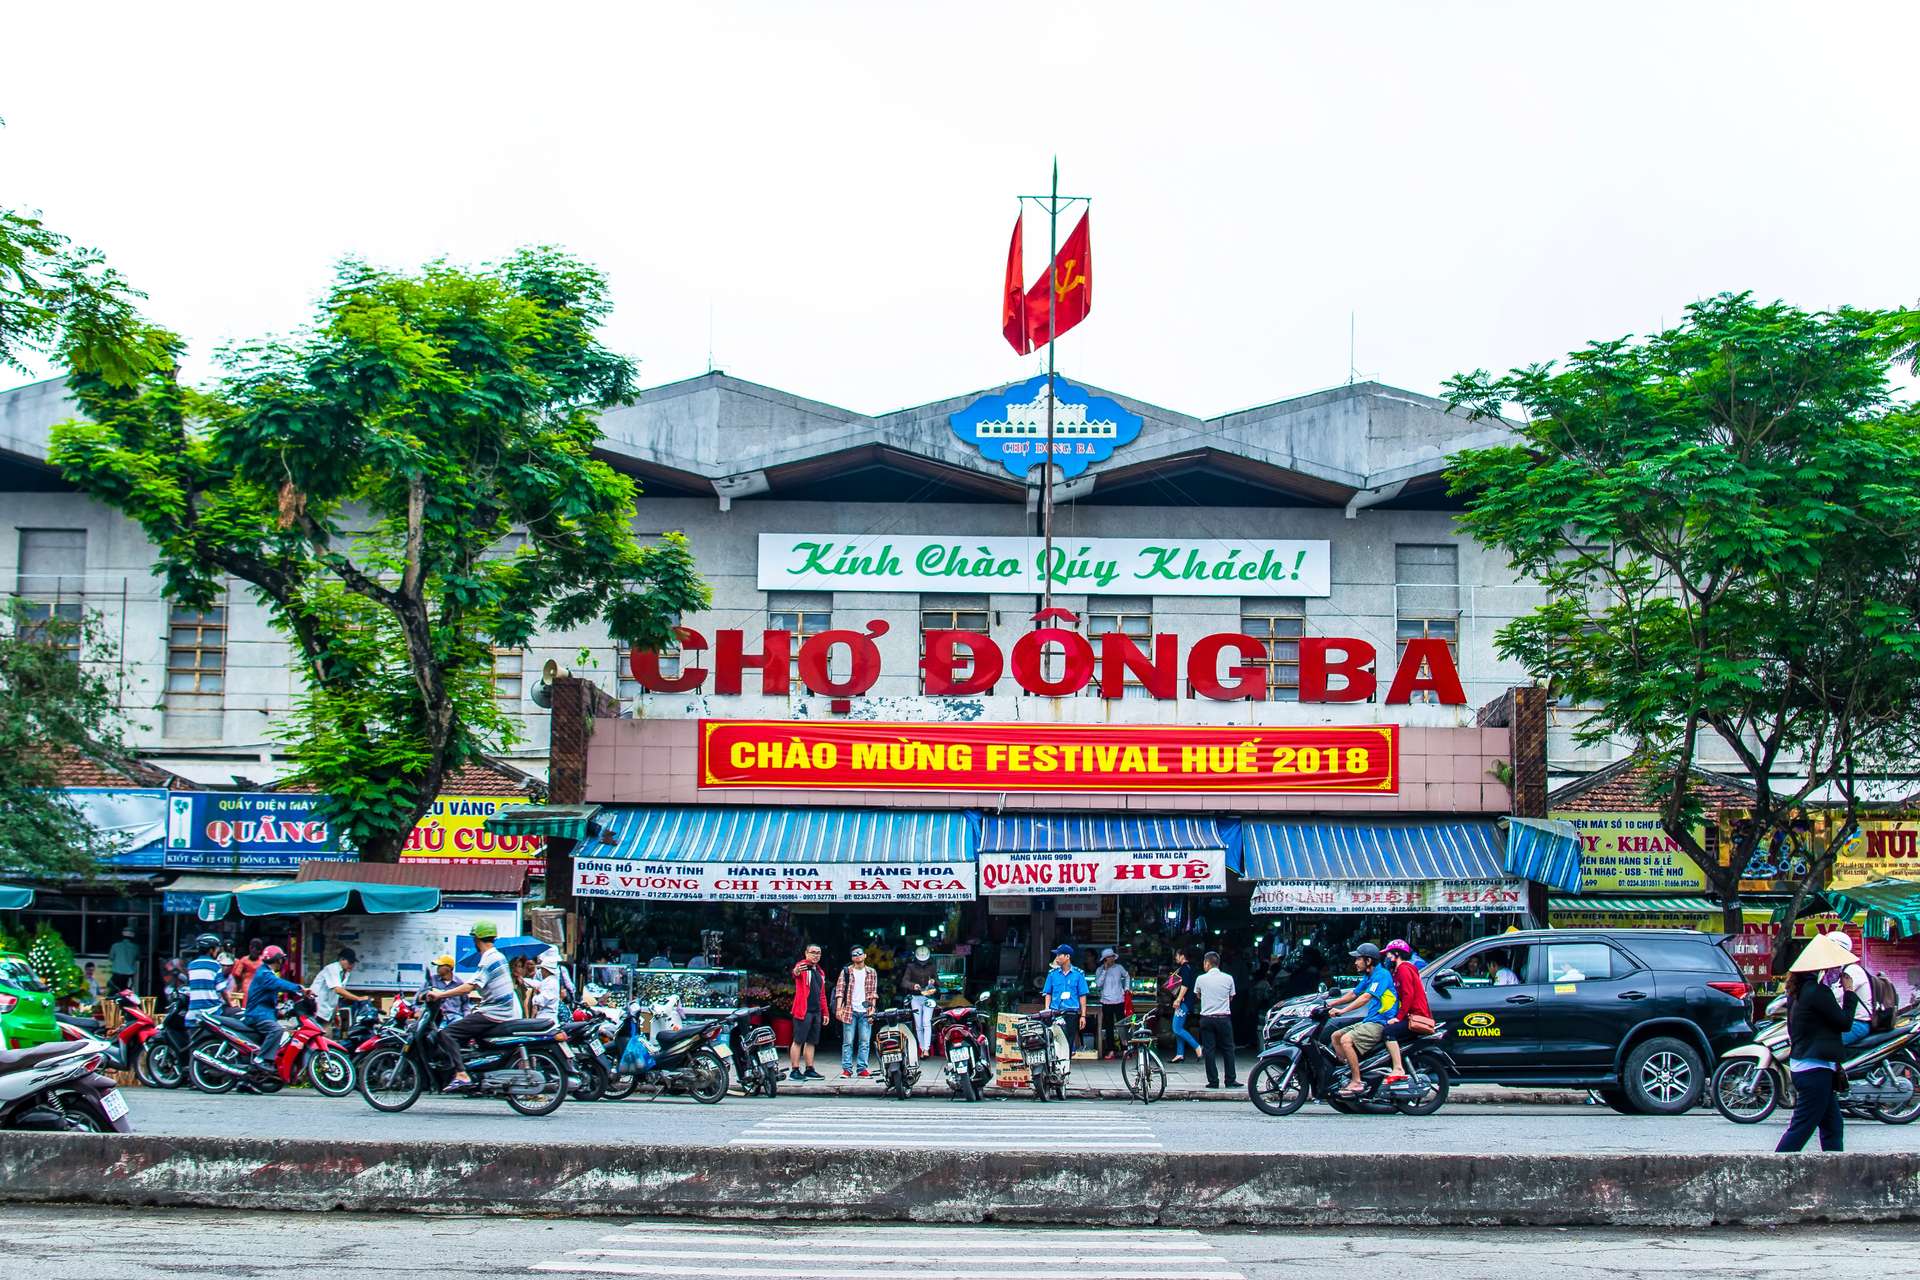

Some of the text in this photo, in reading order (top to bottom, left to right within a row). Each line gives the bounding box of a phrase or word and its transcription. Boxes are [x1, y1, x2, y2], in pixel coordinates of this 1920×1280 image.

[1076, 442, 1095, 454] BA
[786, 542, 903, 576] Kính
[915, 544, 1022, 577] Chào
[1133, 546, 1307, 581] Khách!
[630, 607, 1468, 713] CHỢ ĐÔNG BA
[730, 736, 1369, 774] CHÀO MỪNG FESTIVAL HUẾ 2018
[449, 799, 495, 816] VÀNG
[403, 821, 447, 852] HÚ
[1866, 822, 1919, 859] NÚI
[1654, 857, 1660, 865] &
[728, 865, 819, 876] HÀNG HOA
[860, 866, 954, 876] HÀNG HOA
[983, 863, 1099, 889] QUANG HUY
[1113, 859, 1211, 883] HUỆ
[1625, 867, 1641, 876] USB
[580, 873, 700, 891] LÊ VƯƠNG
[713, 878, 833, 893] CHỊ TÌNH
[848, 877, 967, 891] BÀ NGA
[1457, 1026, 1501, 1037] TAXI VÀNG
